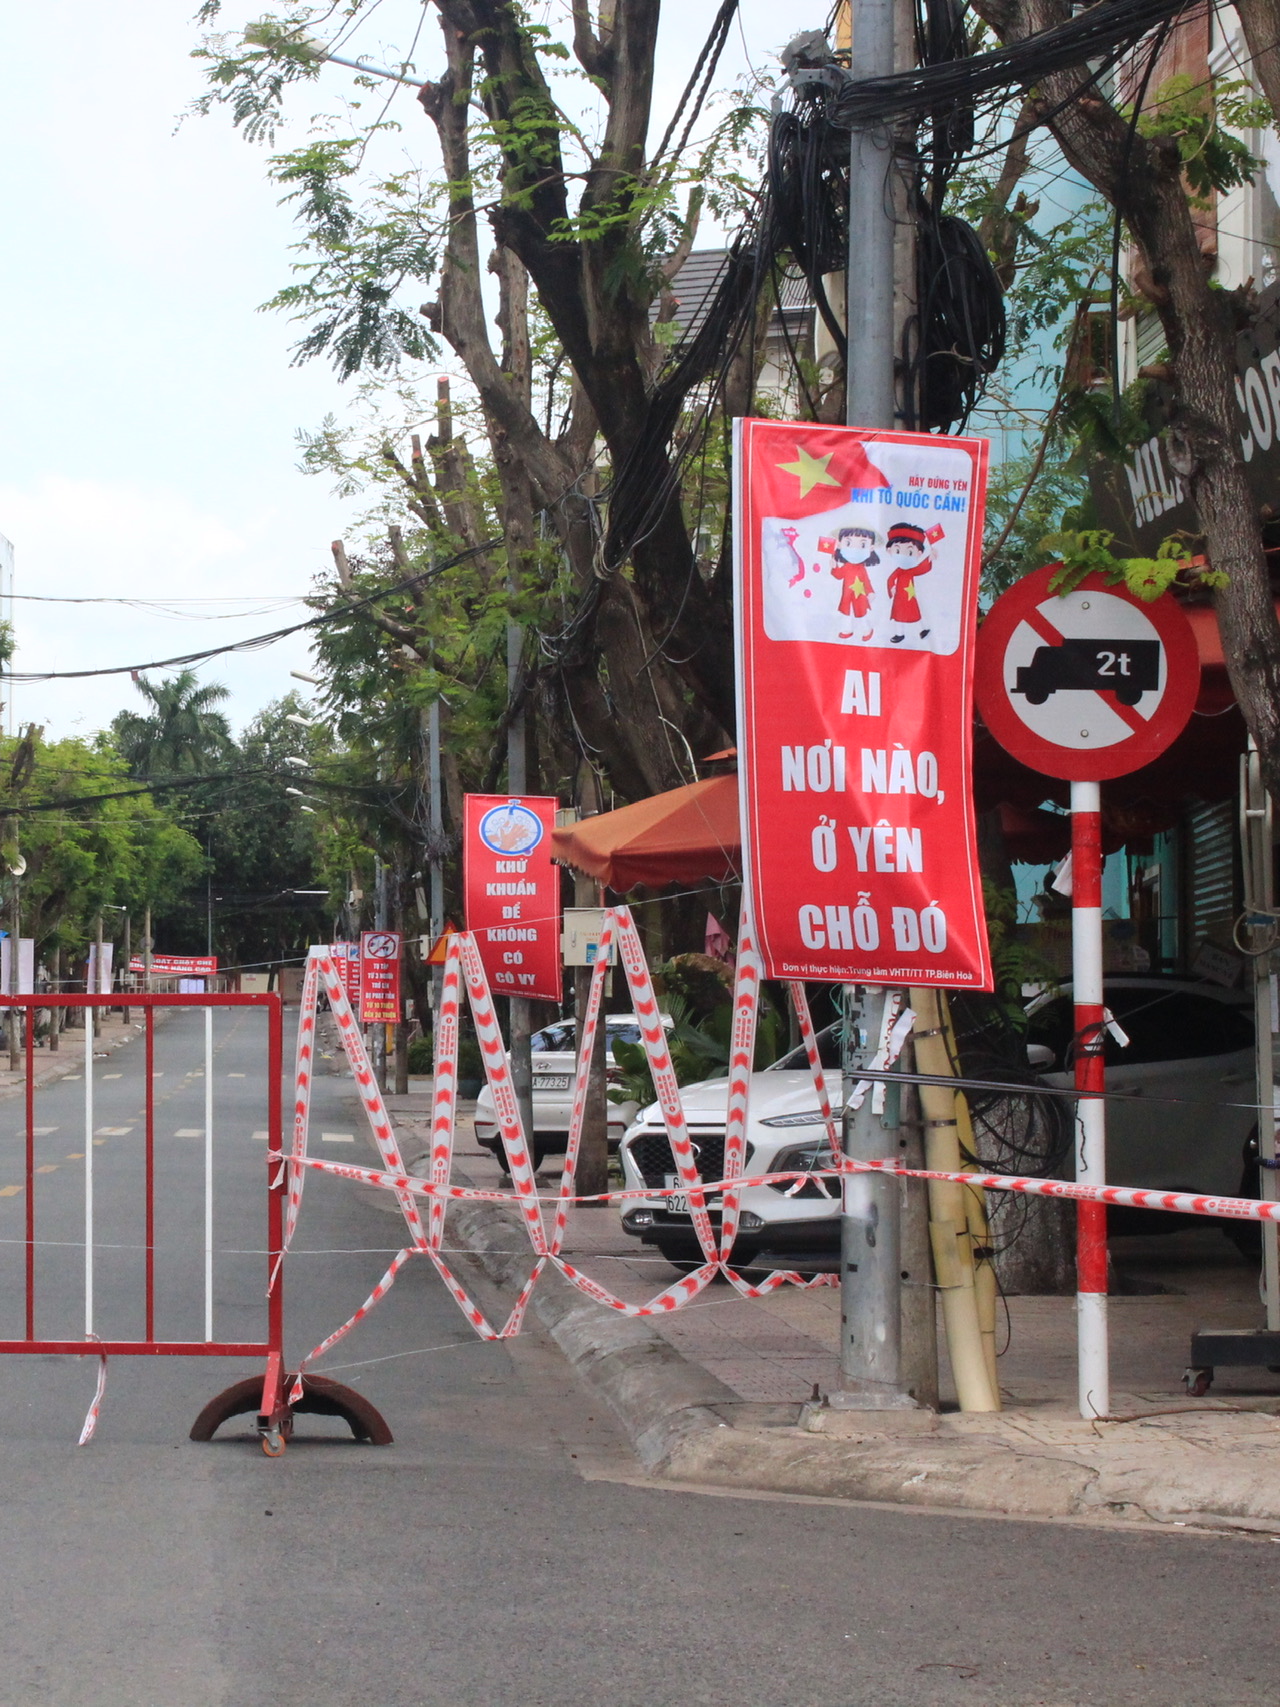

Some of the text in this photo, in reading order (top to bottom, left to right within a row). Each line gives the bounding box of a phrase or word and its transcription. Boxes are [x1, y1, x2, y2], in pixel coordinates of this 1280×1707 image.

[851, 487, 873, 503] KHI
[896, 488, 929, 509] QUỐC
[1096, 651, 1131, 676] 2t
[840, 669, 881, 716] AI
[781, 738, 945, 805] NƠI NÀO,
[811, 815, 923, 873] Ở YÊN
[496, 857, 528, 874] KHỬ
[798, 891, 947, 953] CHỖ ĐÓ
[487, 926, 538, 942] KHÔNG
[503, 950, 523, 965] CÓ
[495, 971, 536, 985] CÔ VY
[782, 963, 799, 973] Đơn
[801, 965, 808, 975] vị
